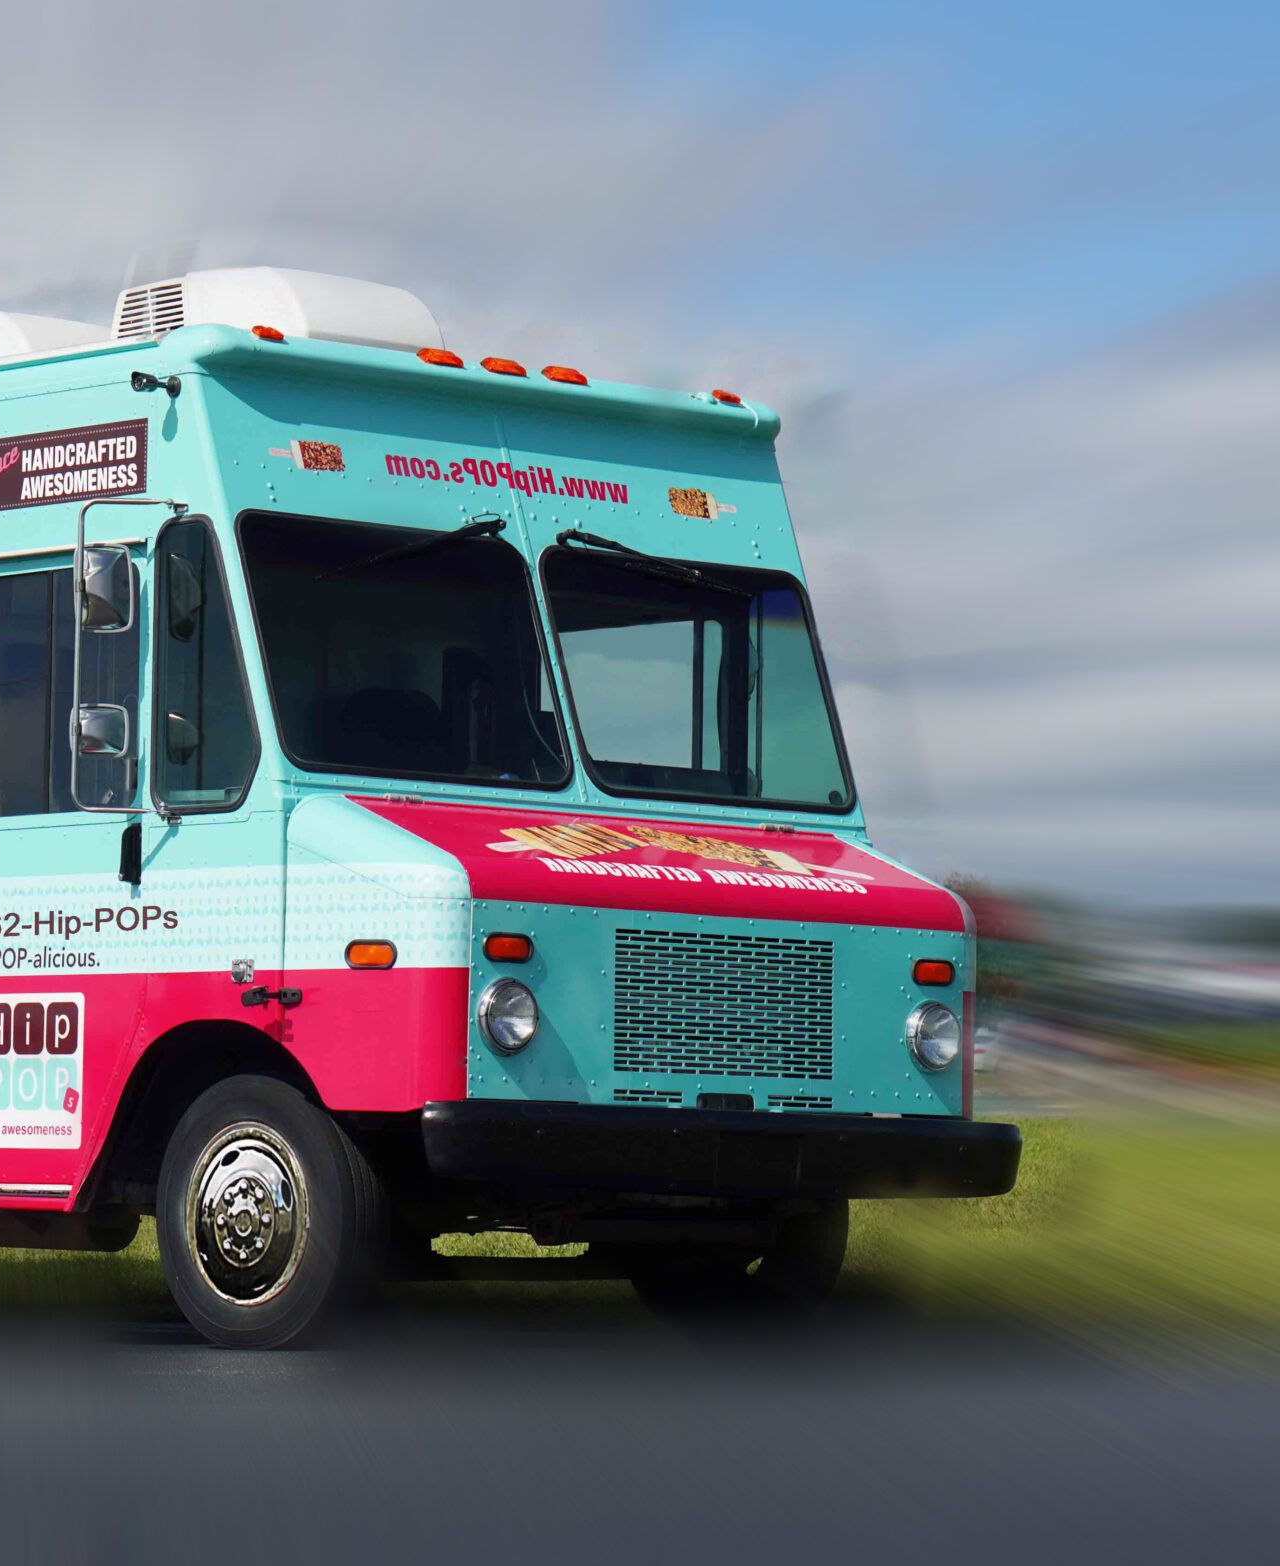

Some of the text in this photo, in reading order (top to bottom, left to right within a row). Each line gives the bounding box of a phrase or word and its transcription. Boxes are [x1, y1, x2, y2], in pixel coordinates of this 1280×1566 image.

[22, 435, 137, 472] HANDCRAFTED
[21, 463, 138, 500] AWESOMENESS
[536, 857, 868, 894] HANDCRAFTED AWESOMENESS
[2, 1123, 72, 1136] awesomeness
